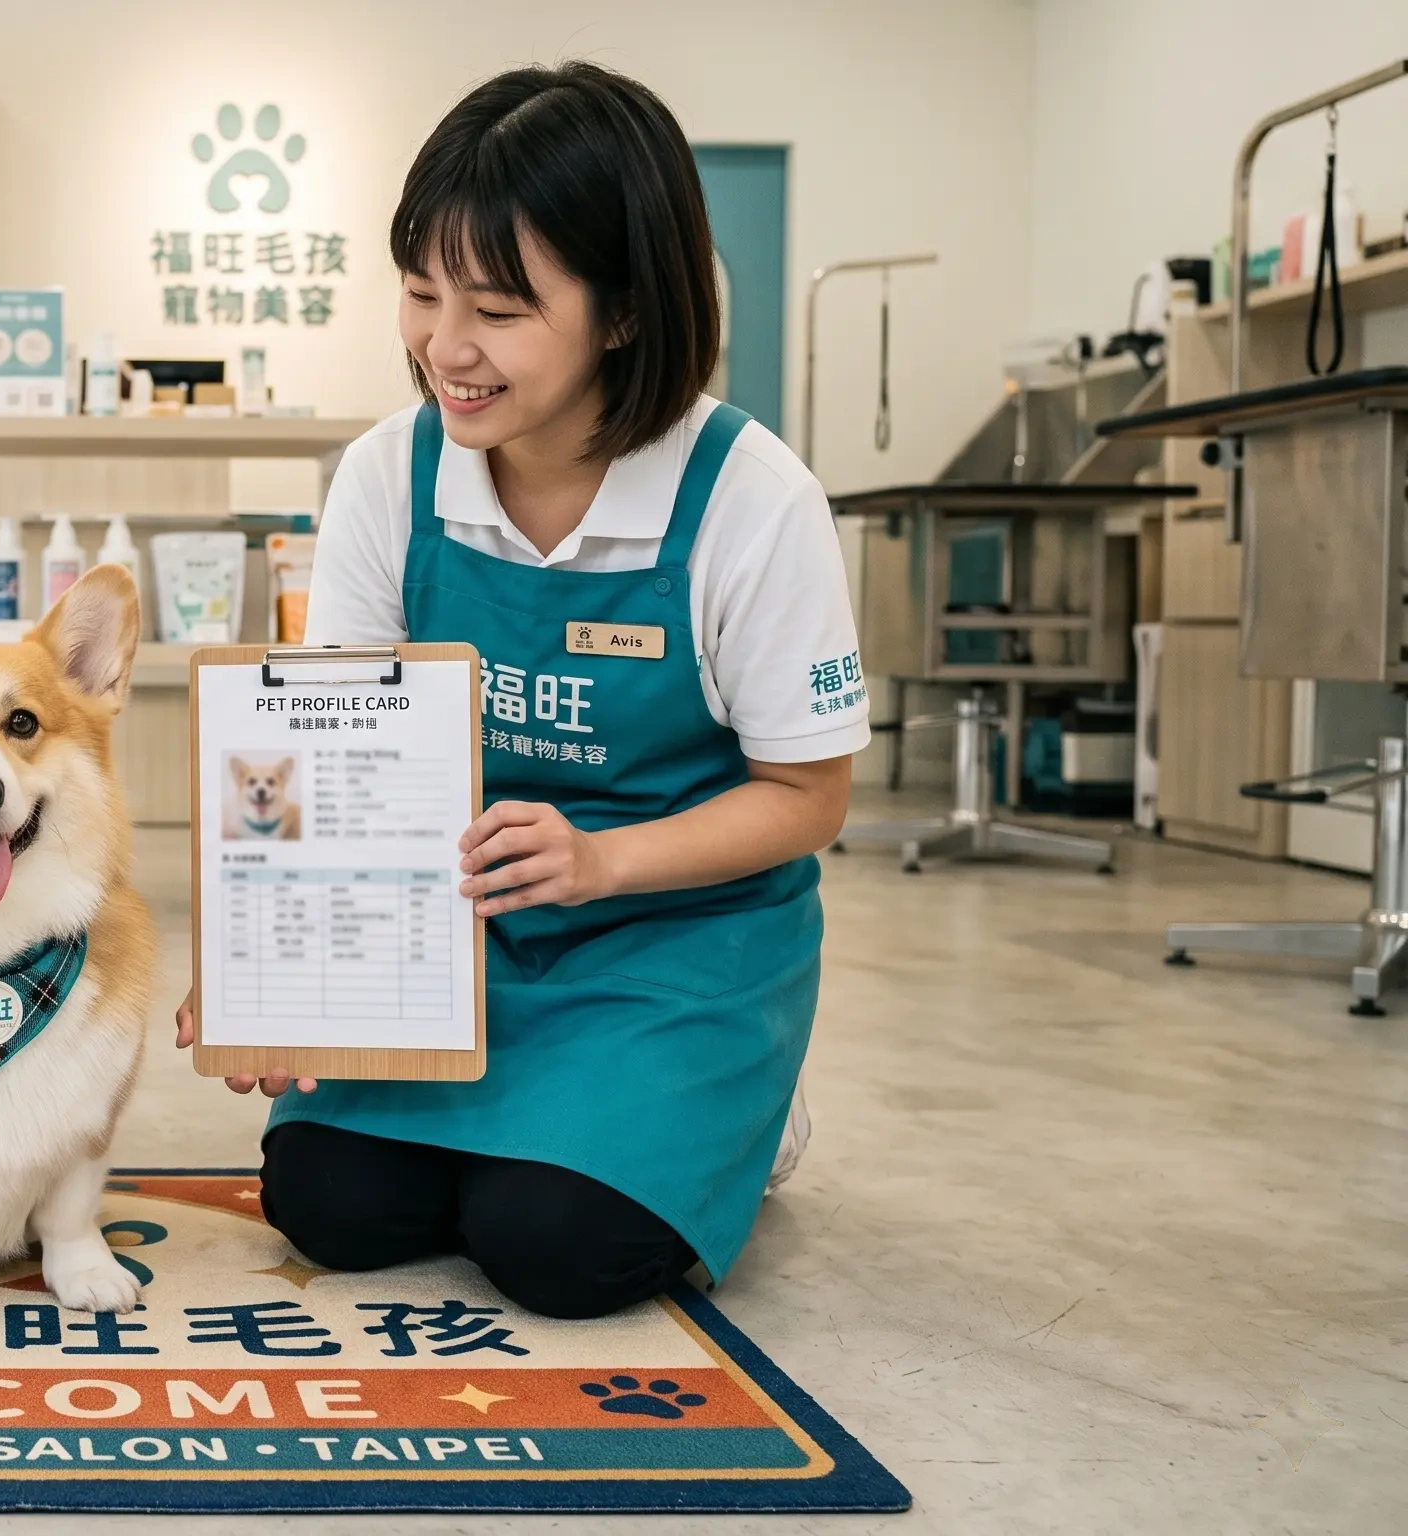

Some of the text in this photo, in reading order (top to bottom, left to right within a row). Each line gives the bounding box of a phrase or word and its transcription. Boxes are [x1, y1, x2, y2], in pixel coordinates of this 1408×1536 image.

[150, 230, 347, 275] 福旺毛孩
[163, 285, 334, 325] 寵物美容
[610, 634, 643, 648] Avis
[809, 650, 862, 696] 福旺
[256, 696, 410, 712] PET PROFILE CARD
[480, 657, 595, 733] 福旺
[298, 1436, 545, 1462] TAIPEI
